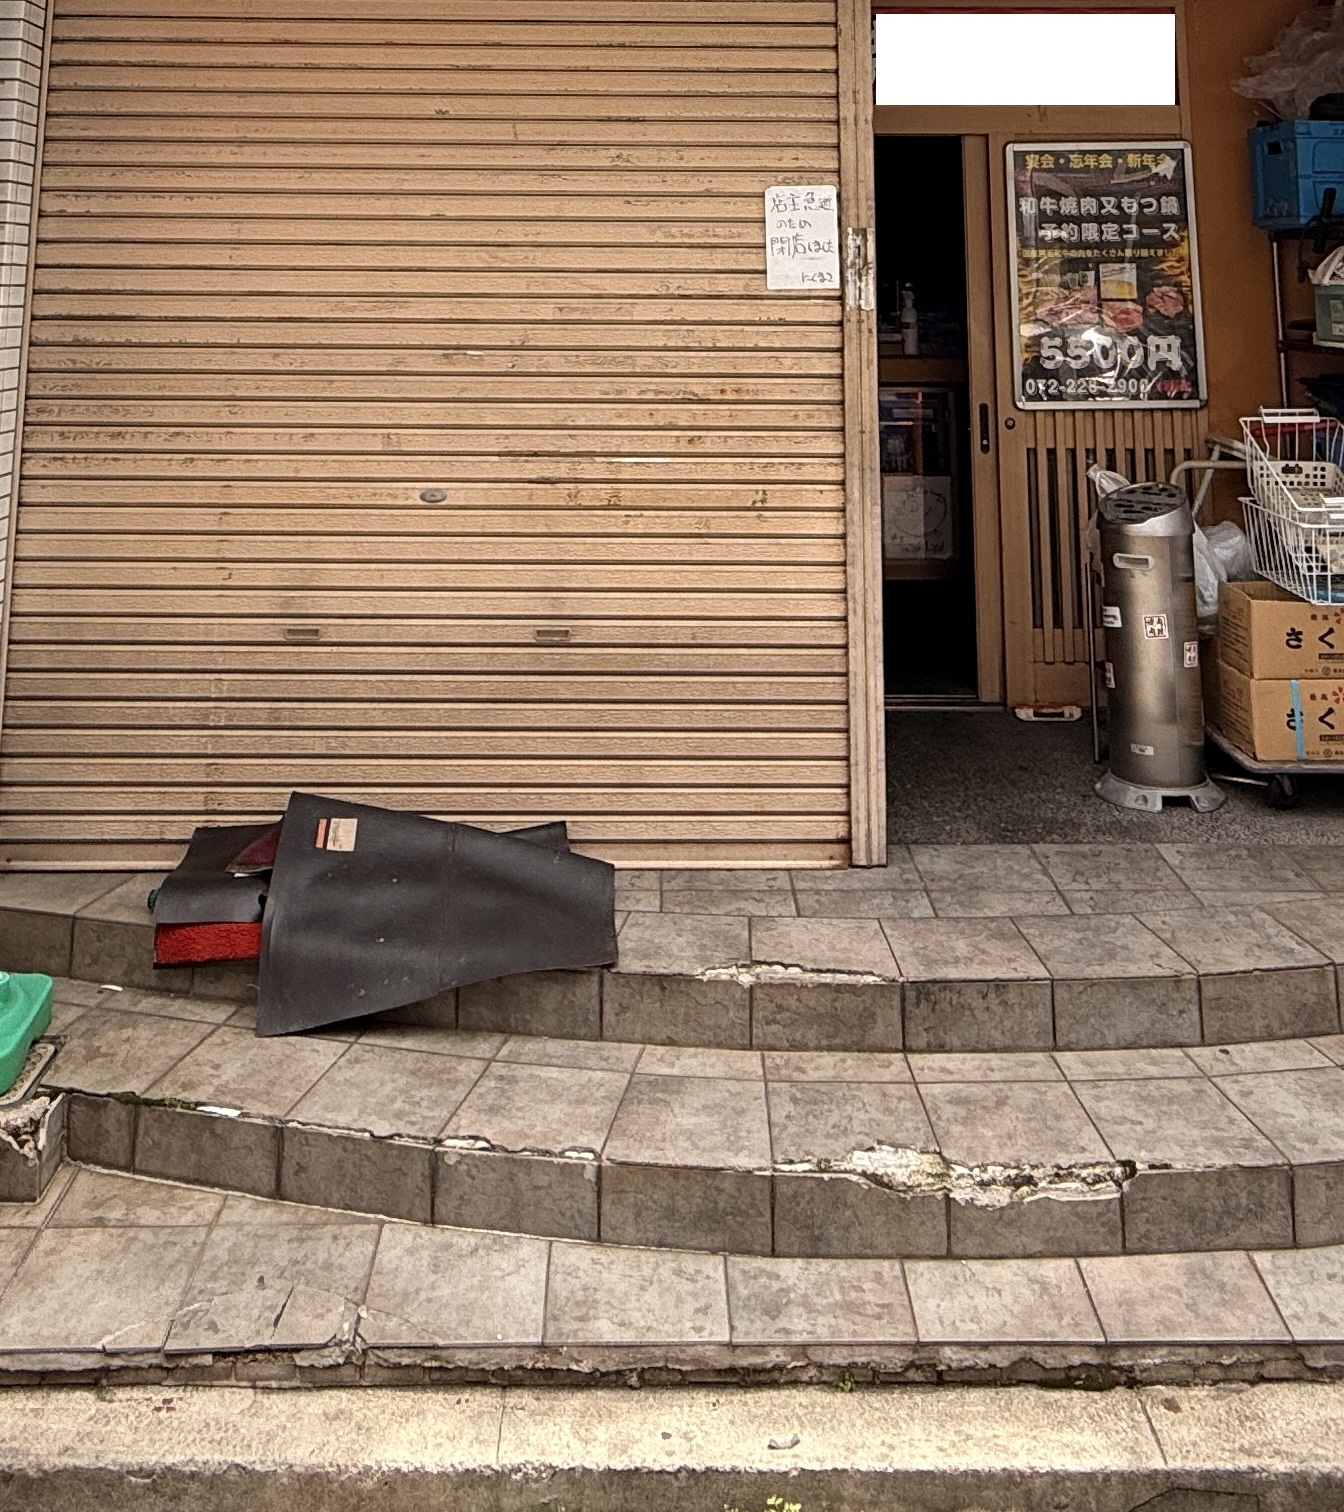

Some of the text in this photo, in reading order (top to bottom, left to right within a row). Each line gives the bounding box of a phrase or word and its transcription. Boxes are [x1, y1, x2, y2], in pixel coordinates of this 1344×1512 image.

[1019, 196, 1180, 216] 和牛焼肉又もつ鍋
[1038, 223, 1181, 242] 予約限定コース
[1039, 335, 1183, 371] 5500円
